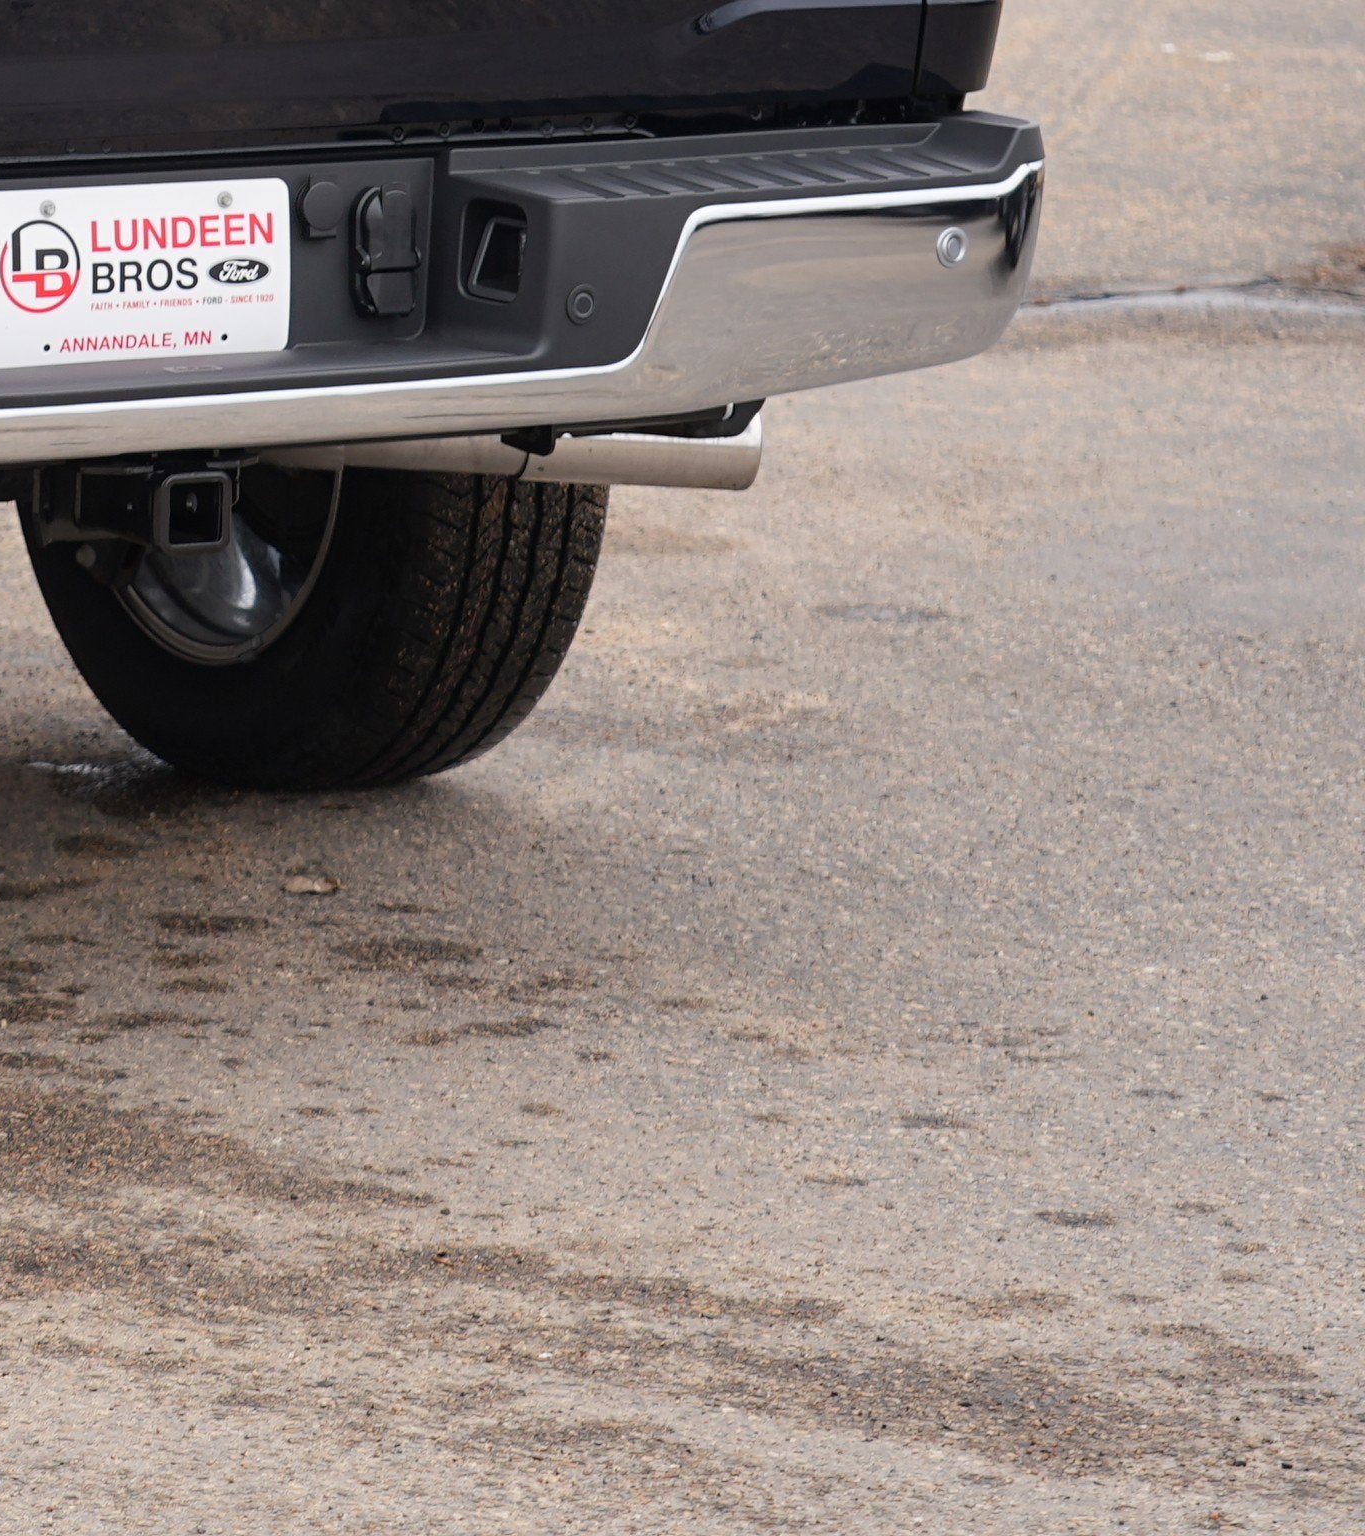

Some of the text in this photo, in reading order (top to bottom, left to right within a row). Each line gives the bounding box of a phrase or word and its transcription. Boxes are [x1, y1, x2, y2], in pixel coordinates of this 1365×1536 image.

[90, 212, 274, 253] LUNDEEN
[92, 257, 199, 295] BROS
[90, 301, 114, 312] FAITH
[122, 300, 151, 310] FAMILY
[160, 298, 193, 308] FRIENDS
[202, 296, 223, 305] FORD
[230, 295, 253, 304] SINCE
[59, 330, 212, 354] ANNANDALE, MN
